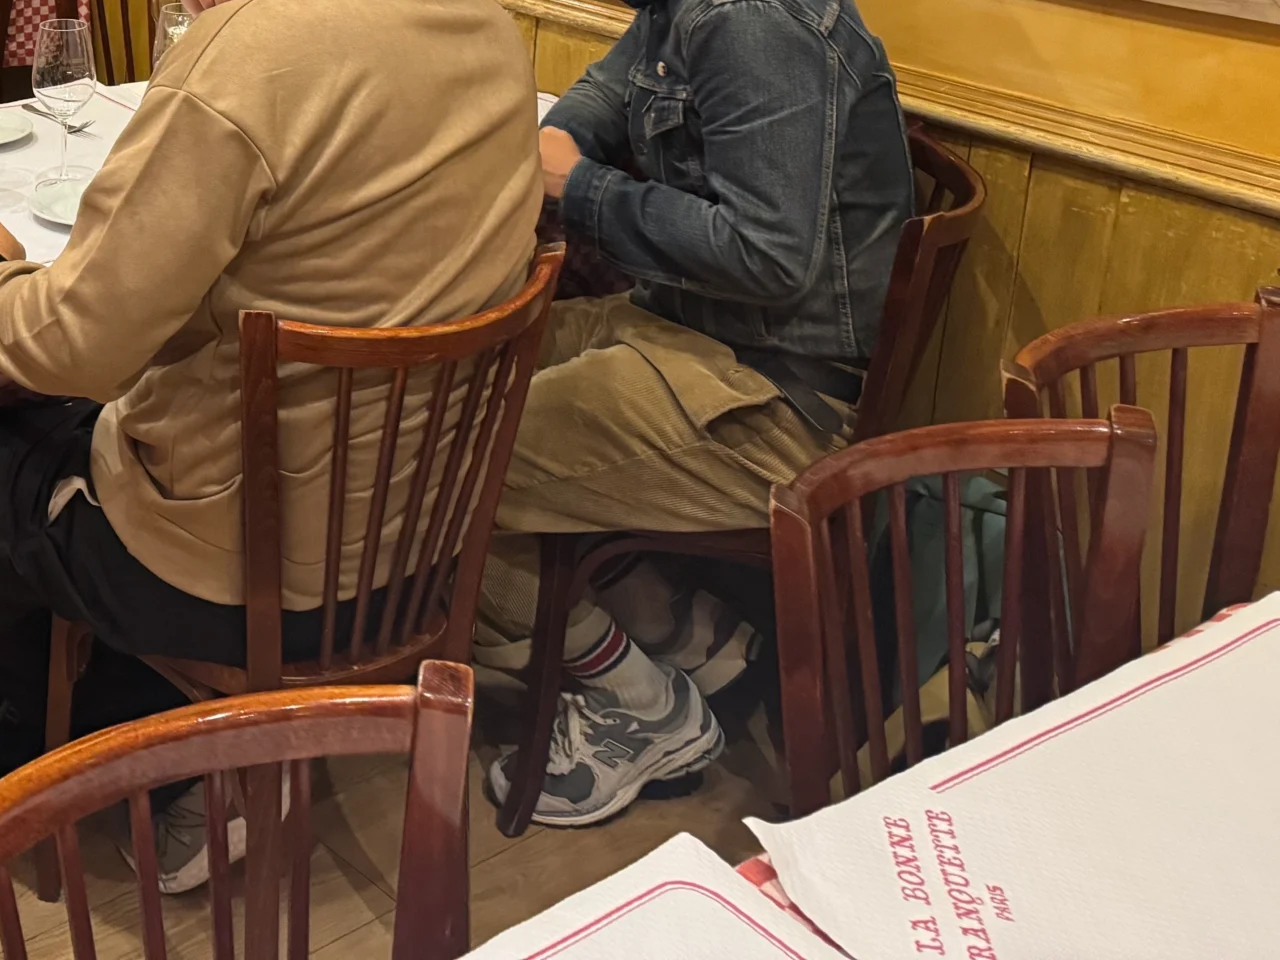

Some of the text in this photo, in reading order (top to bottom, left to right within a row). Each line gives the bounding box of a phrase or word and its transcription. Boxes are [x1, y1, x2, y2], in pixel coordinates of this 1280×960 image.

[882, 816, 945, 956] LA BONNE
[924, 809, 997, 960] RANQUETTE
[985, 883, 1016, 923] PARIS
